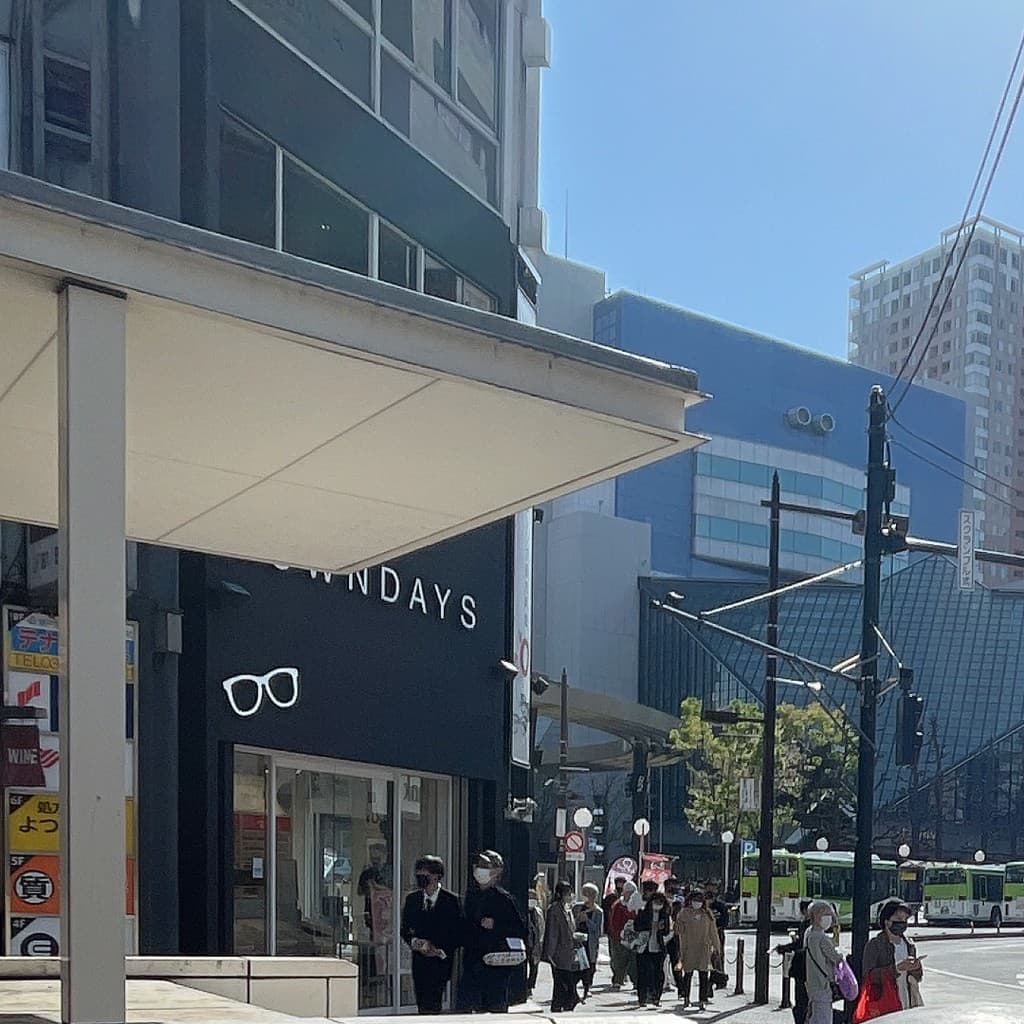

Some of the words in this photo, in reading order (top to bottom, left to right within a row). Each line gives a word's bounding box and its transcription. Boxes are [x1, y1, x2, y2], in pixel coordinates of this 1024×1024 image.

[273, 564, 477, 629] NDAYS
[8, 748, 37, 764] WINE
[19, 816, 59, 833] よつ
[11, 856, 24, 866] 5F
[20, 875, 50, 900] 質
